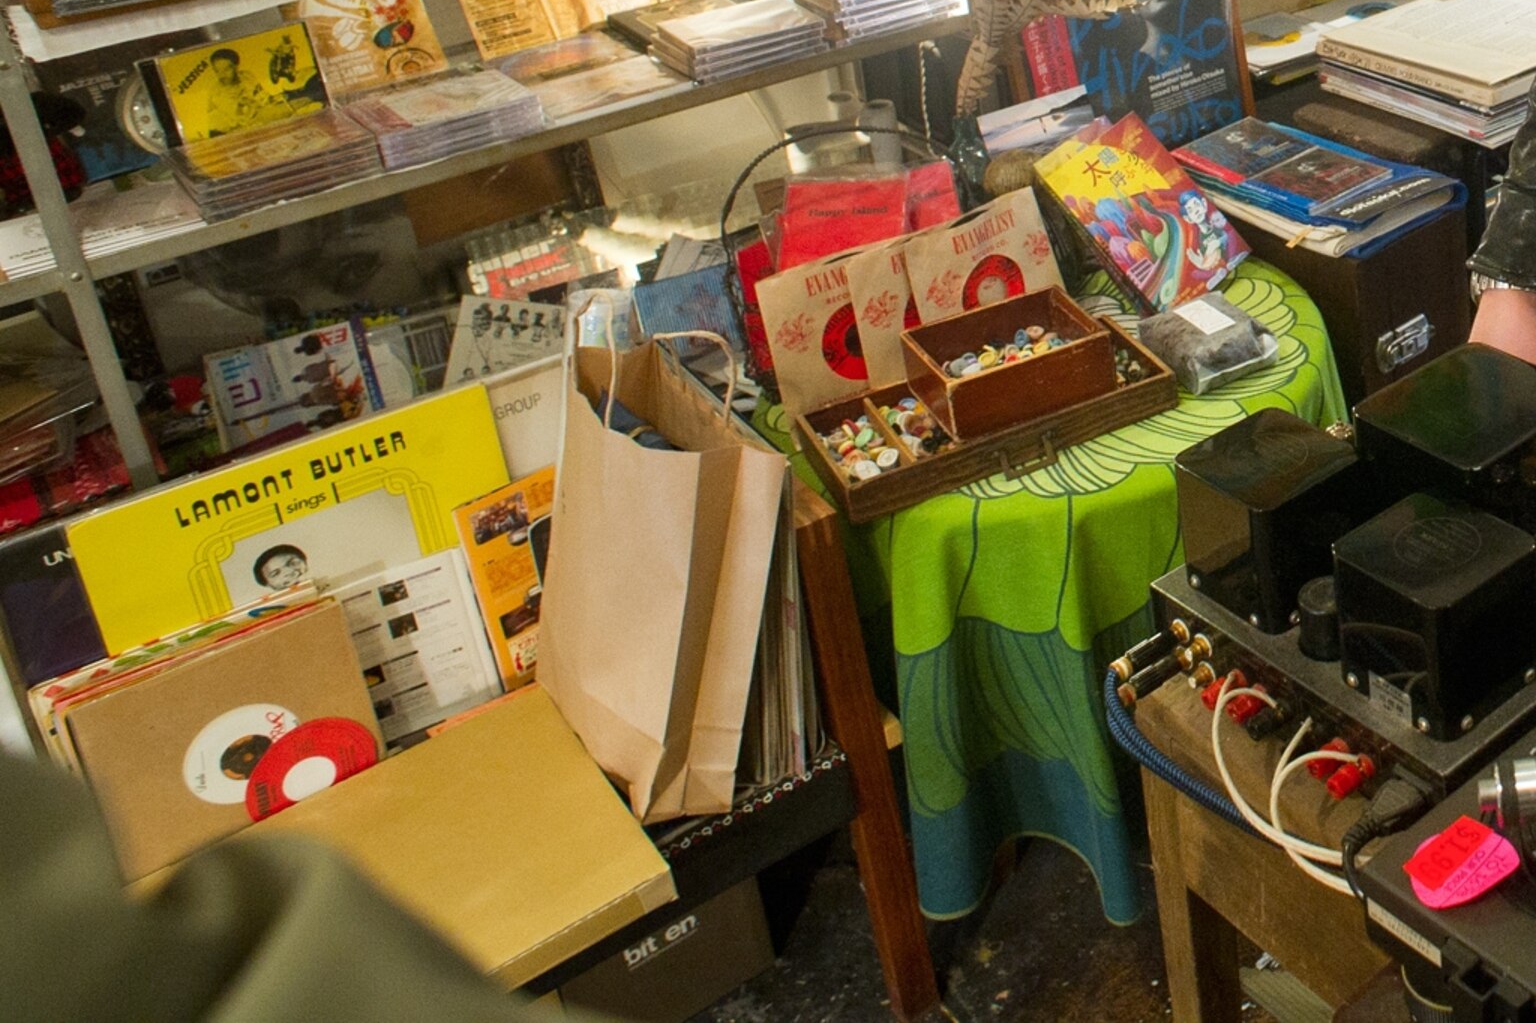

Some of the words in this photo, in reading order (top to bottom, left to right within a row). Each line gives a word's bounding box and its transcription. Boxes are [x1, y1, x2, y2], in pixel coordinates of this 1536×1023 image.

[952, 209, 1016, 255] EVANGELIST
[494, 392, 543, 421] GROUP
[175, 469, 295, 529] LAMONT
[309, 430, 407, 481] BUTLER
[286, 491, 329, 517] sings
[1417, 824, 1482, 879] $1.99
